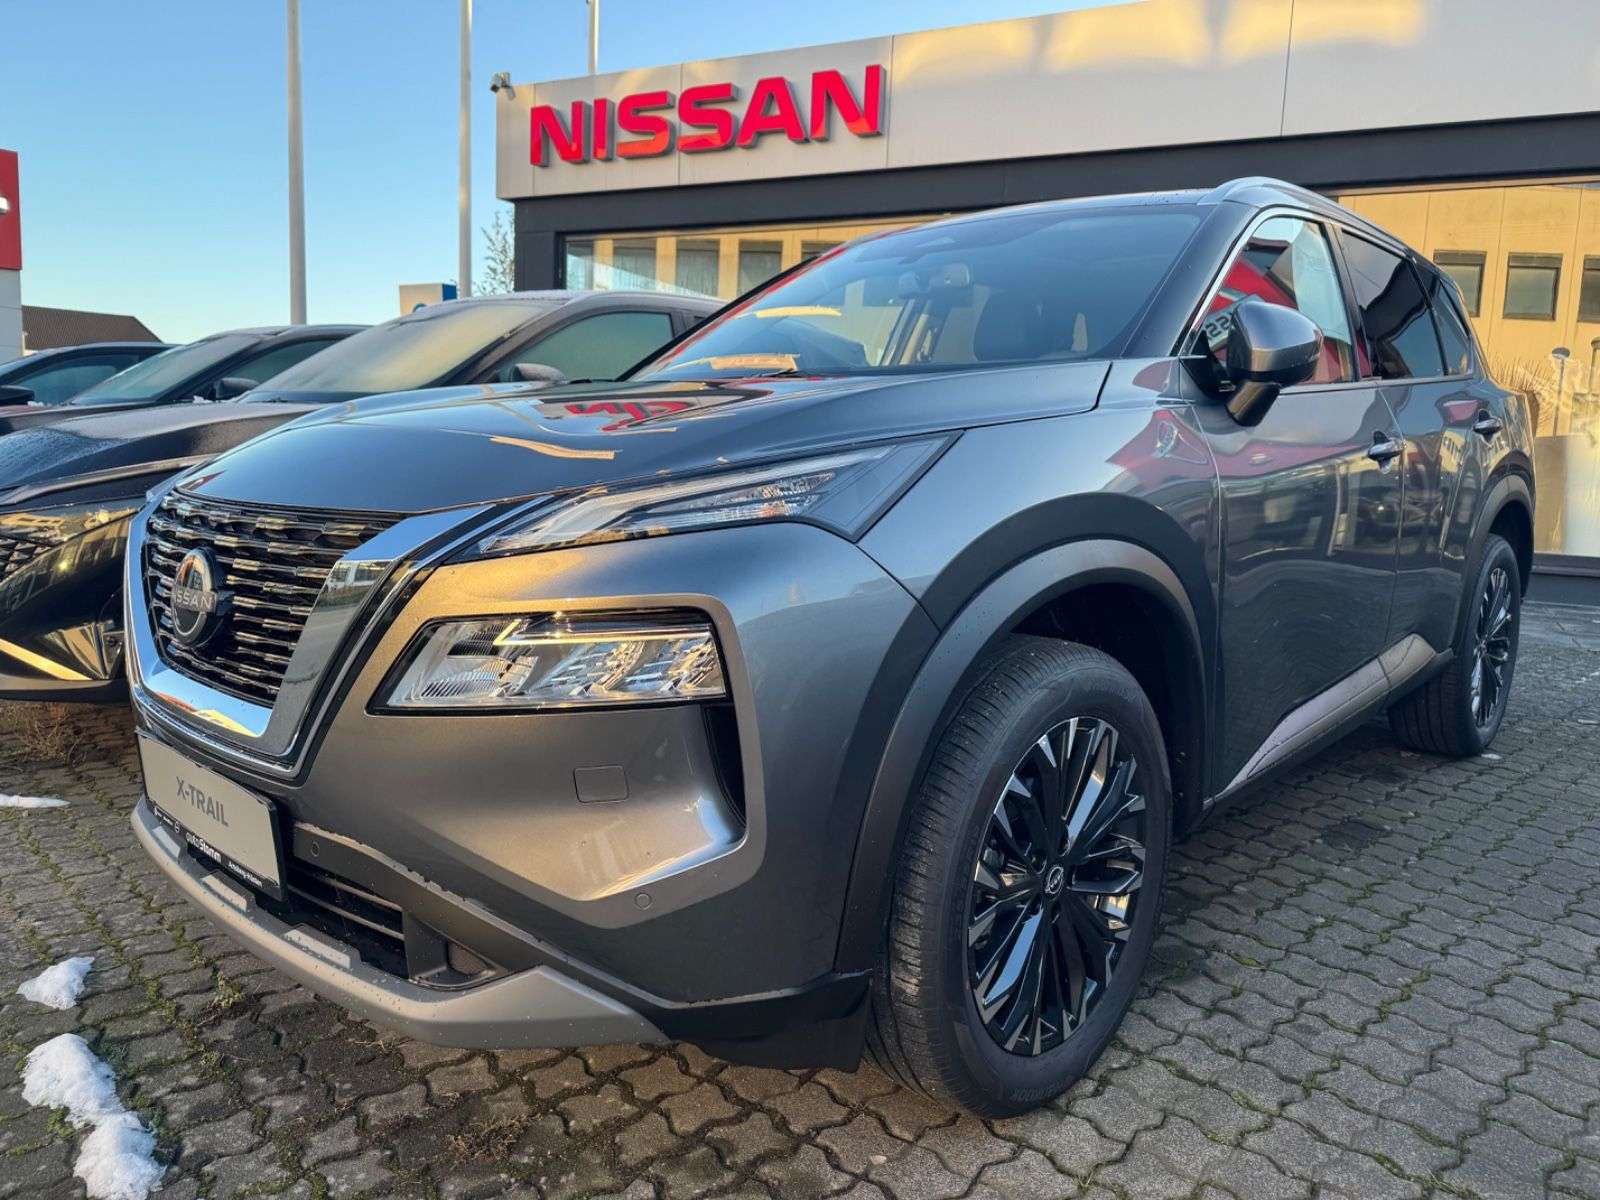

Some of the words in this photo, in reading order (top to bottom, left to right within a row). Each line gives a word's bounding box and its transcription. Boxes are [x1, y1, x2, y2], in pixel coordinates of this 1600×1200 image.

[530, 64, 884, 167] NISSAN
[174, 589, 213, 610] SSAN
[176, 776, 229, 827] X-TRAIL
